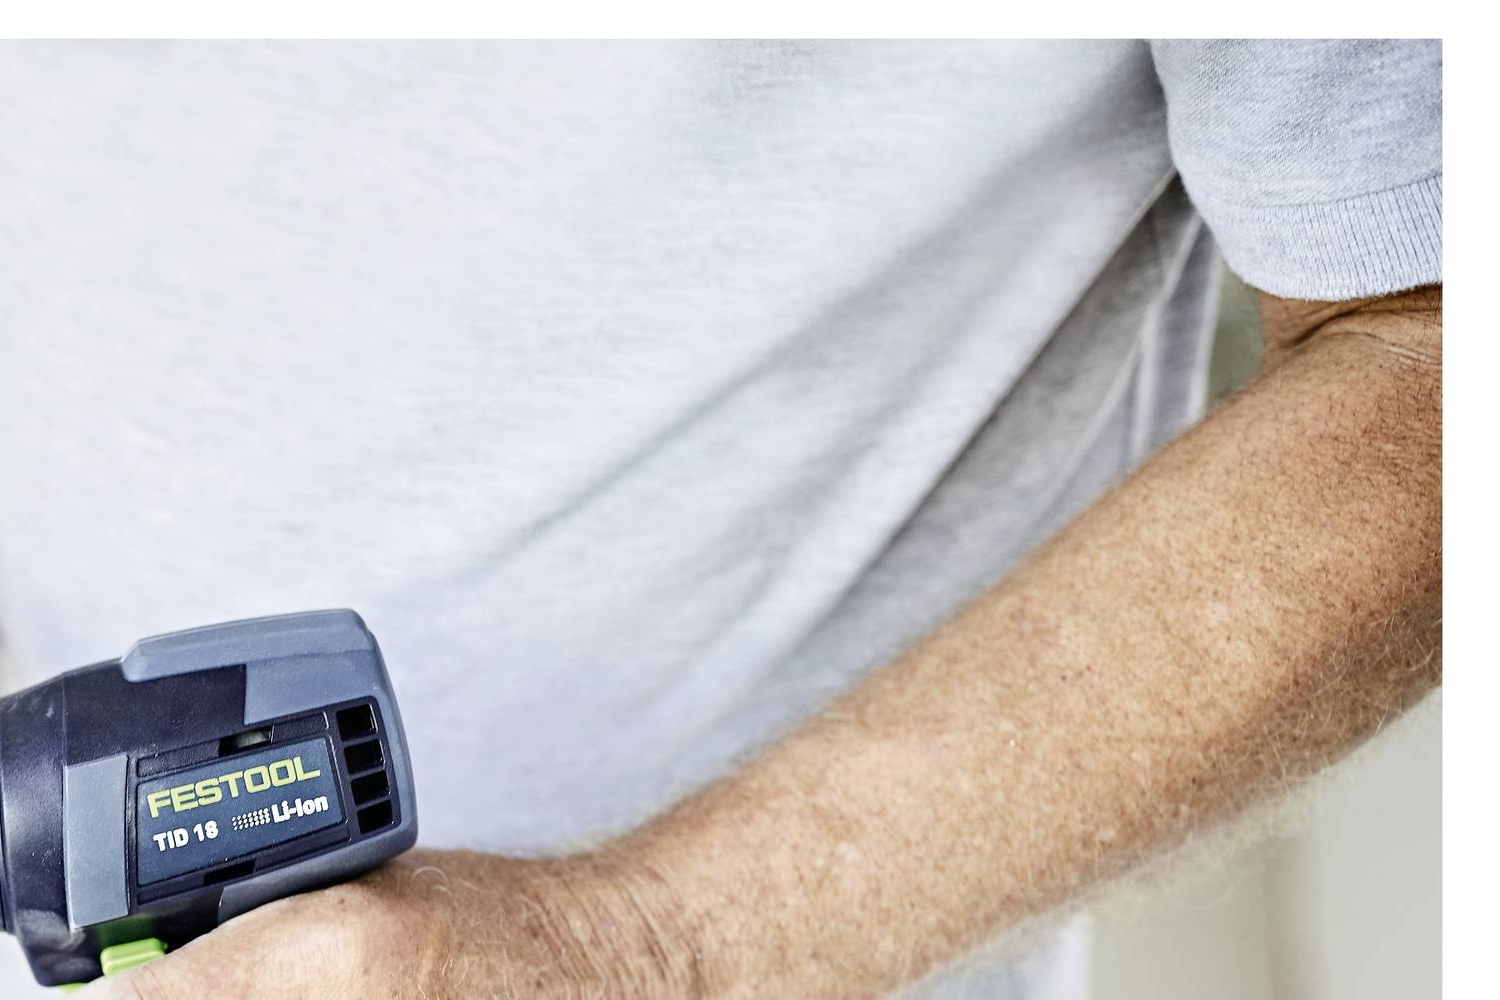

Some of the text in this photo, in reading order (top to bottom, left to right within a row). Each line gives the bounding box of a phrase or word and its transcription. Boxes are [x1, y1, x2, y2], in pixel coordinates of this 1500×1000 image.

[147, 756, 321, 818] FESTOOL
[153, 795, 329, 851] TID 18 Li-Ion
